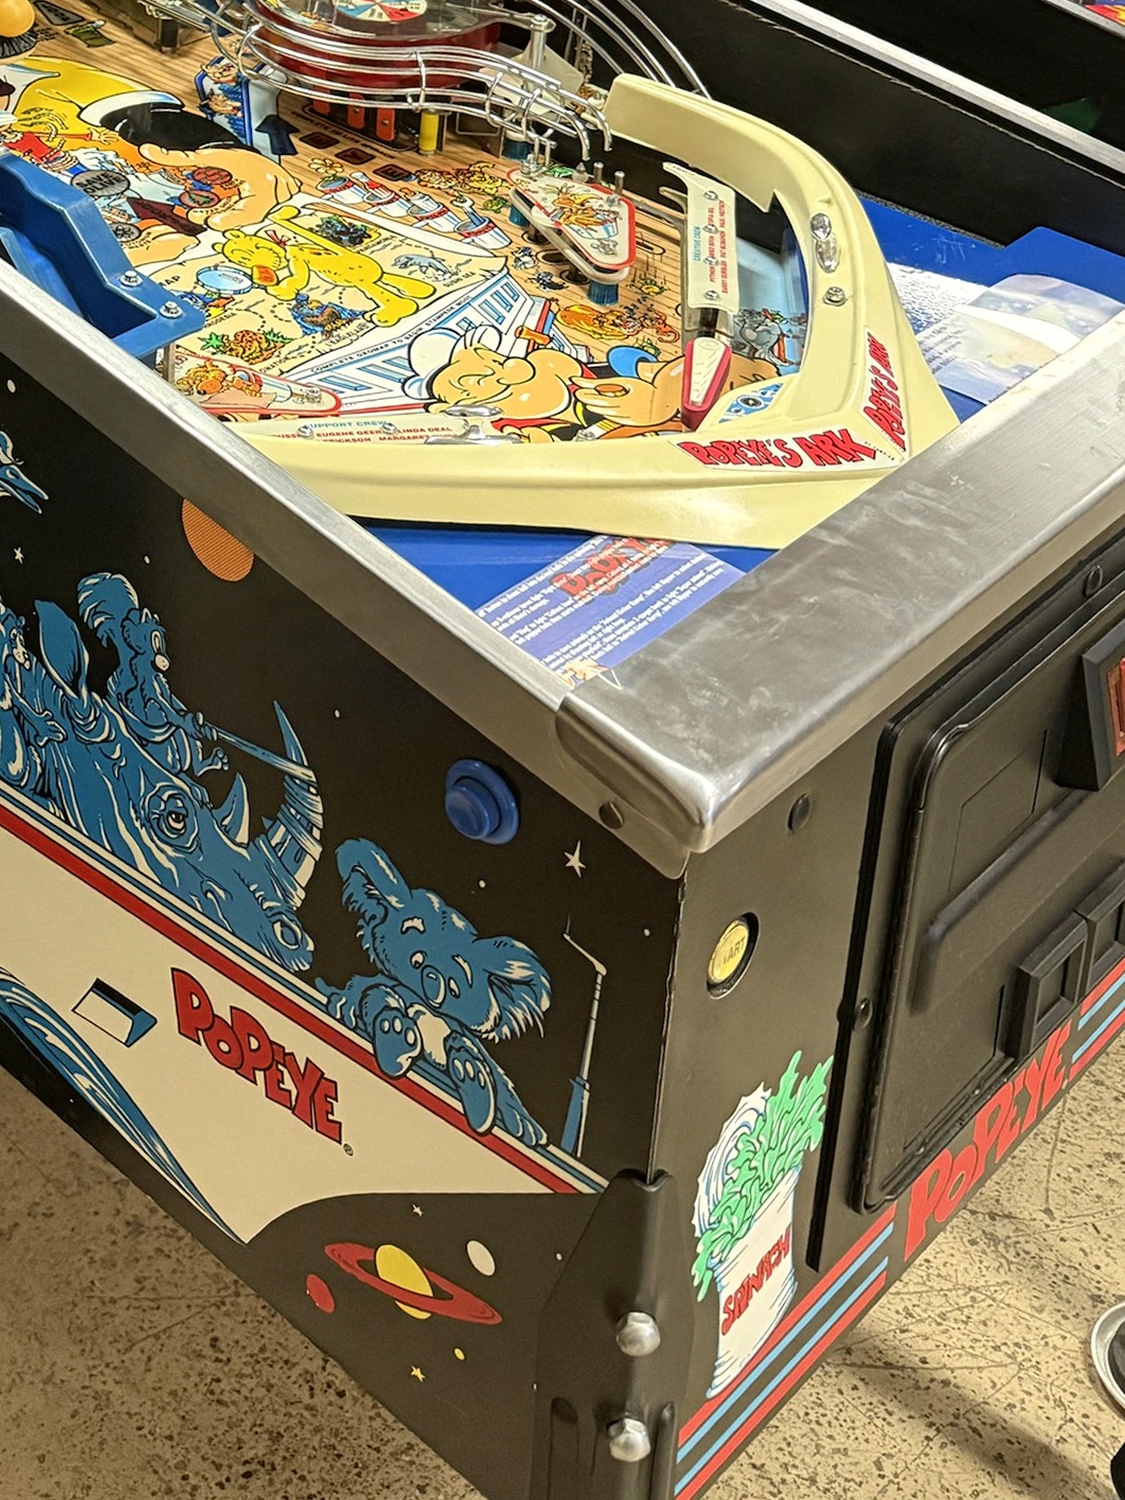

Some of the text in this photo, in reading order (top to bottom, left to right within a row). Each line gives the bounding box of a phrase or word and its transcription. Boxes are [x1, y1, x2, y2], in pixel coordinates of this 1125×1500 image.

[77, 172, 111, 189] SAVE
[83, 176, 125, 194] OLIVE
[310, 355, 355, 373] COMPLETE
[405, 328, 424, 341] BEGIN
[425, 309, 456, 328] STAMPEDE
[867, 331, 895, 379] ARK
[308, 420, 387, 430] UPPORT CREW
[316, 430, 355, 438] EUGENE
[397, 428, 426, 436] LINDA
[677, 438, 803, 468] POPEYE'S
[793, 428, 876, 467] ARK
[170, 967, 342, 1145] POPEYE
[904, 1018, 1074, 1262] POPEYE
[721, 1231, 792, 1336] SPINACH
